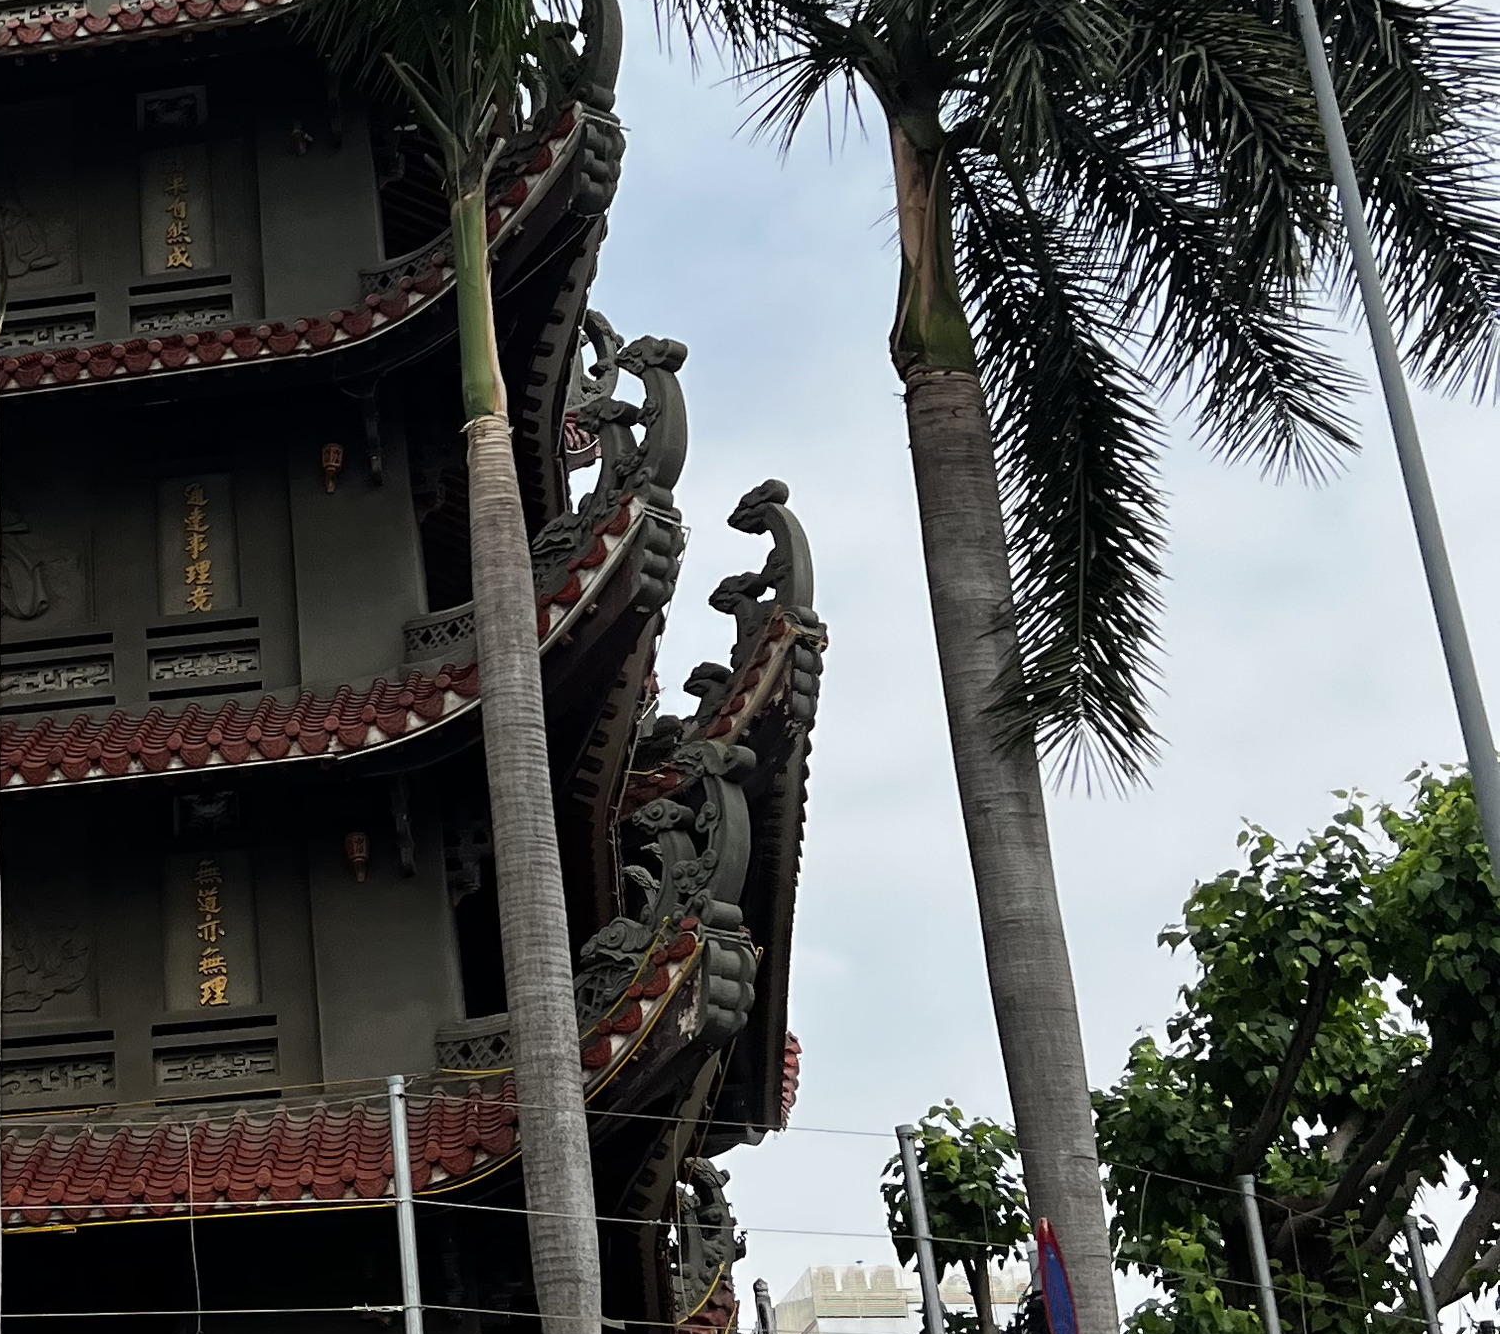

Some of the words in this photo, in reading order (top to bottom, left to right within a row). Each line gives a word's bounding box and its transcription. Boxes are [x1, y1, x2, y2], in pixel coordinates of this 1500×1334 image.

[194, 858, 229, 1006] 無道亦無理
